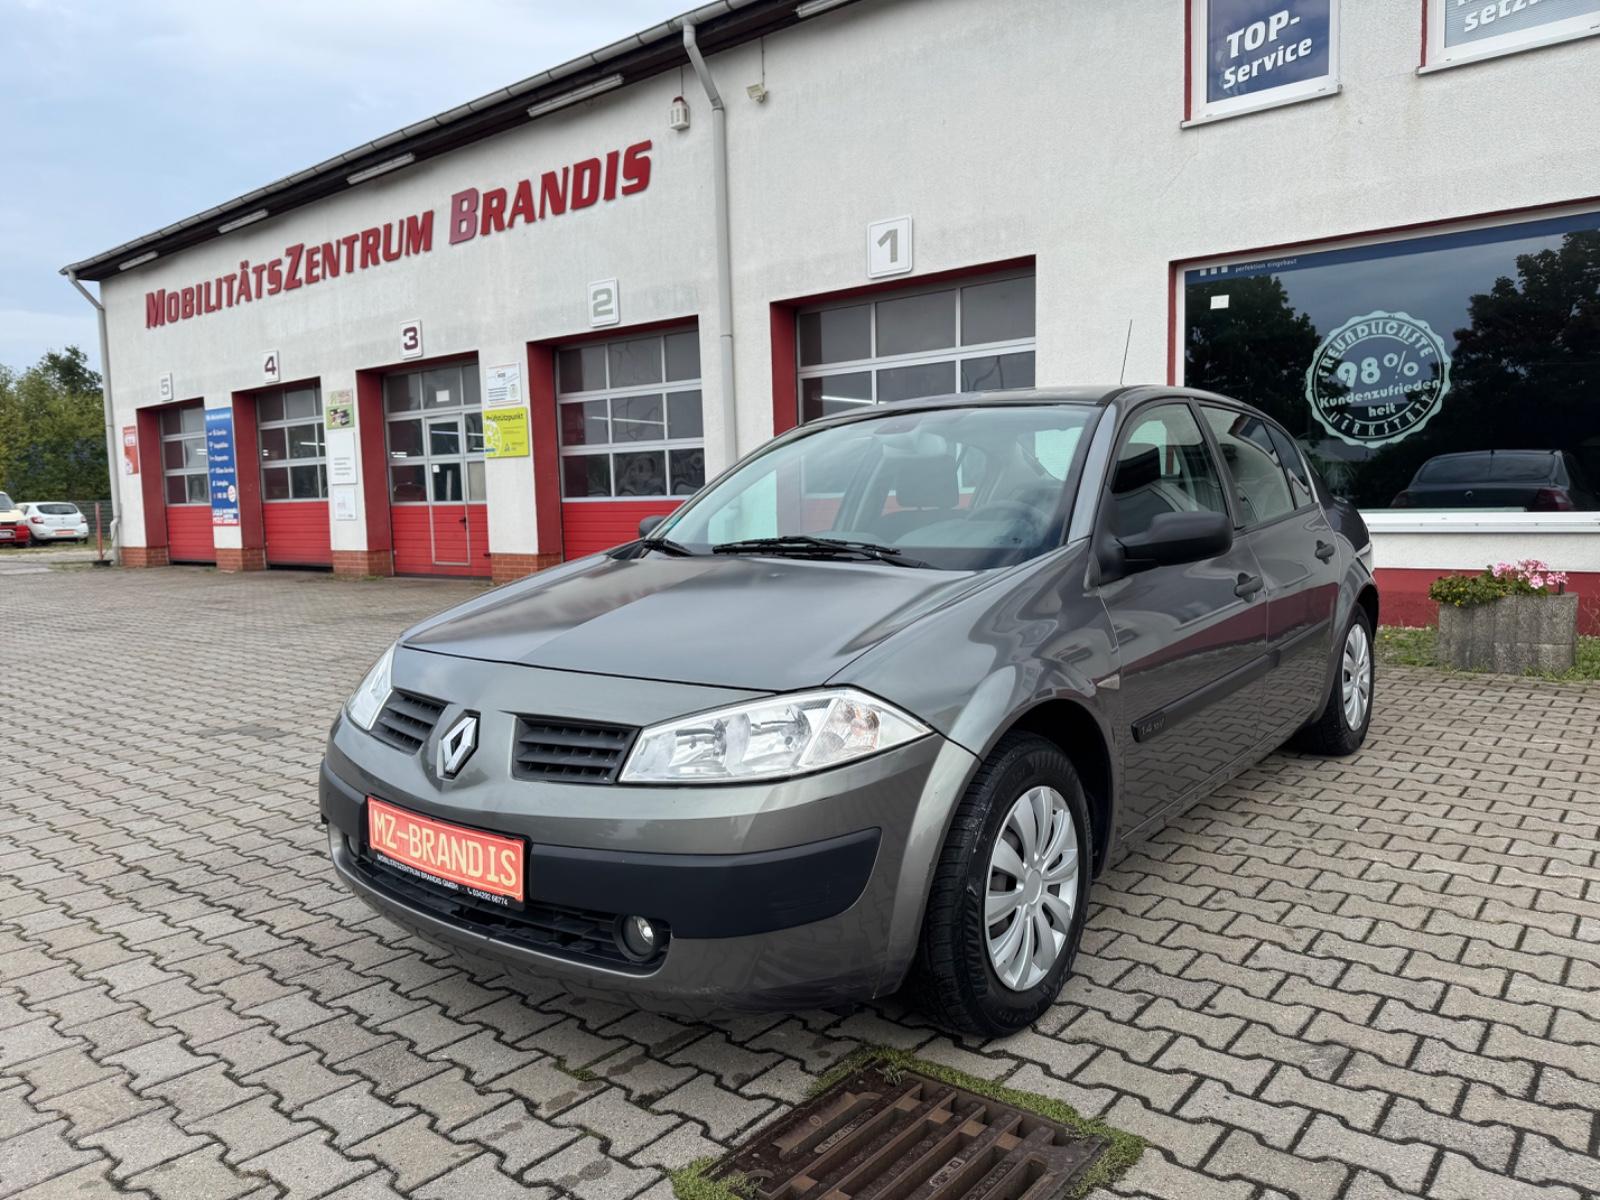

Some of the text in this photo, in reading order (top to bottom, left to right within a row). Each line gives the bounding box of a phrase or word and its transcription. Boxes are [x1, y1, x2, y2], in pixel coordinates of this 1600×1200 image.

[1226, 10, 1300, 59] TOP-
[1223, 38, 1312, 90] Service
[449, 140, 653, 244] BRANDIS
[877, 228, 898, 264] 1
[592, 287, 614, 317] 2
[403, 326, 419, 351] 3
[1319, 320, 1434, 378] FREUNDLICHSTE
[264, 355, 277, 376] 4
[160, 377, 170, 396] 5
[1320, 379, 1440, 409] Kundenzufrieden
[1368, 402, 1396, 418] heit
[373, 810, 517, 887] MZ-BRANDIS
